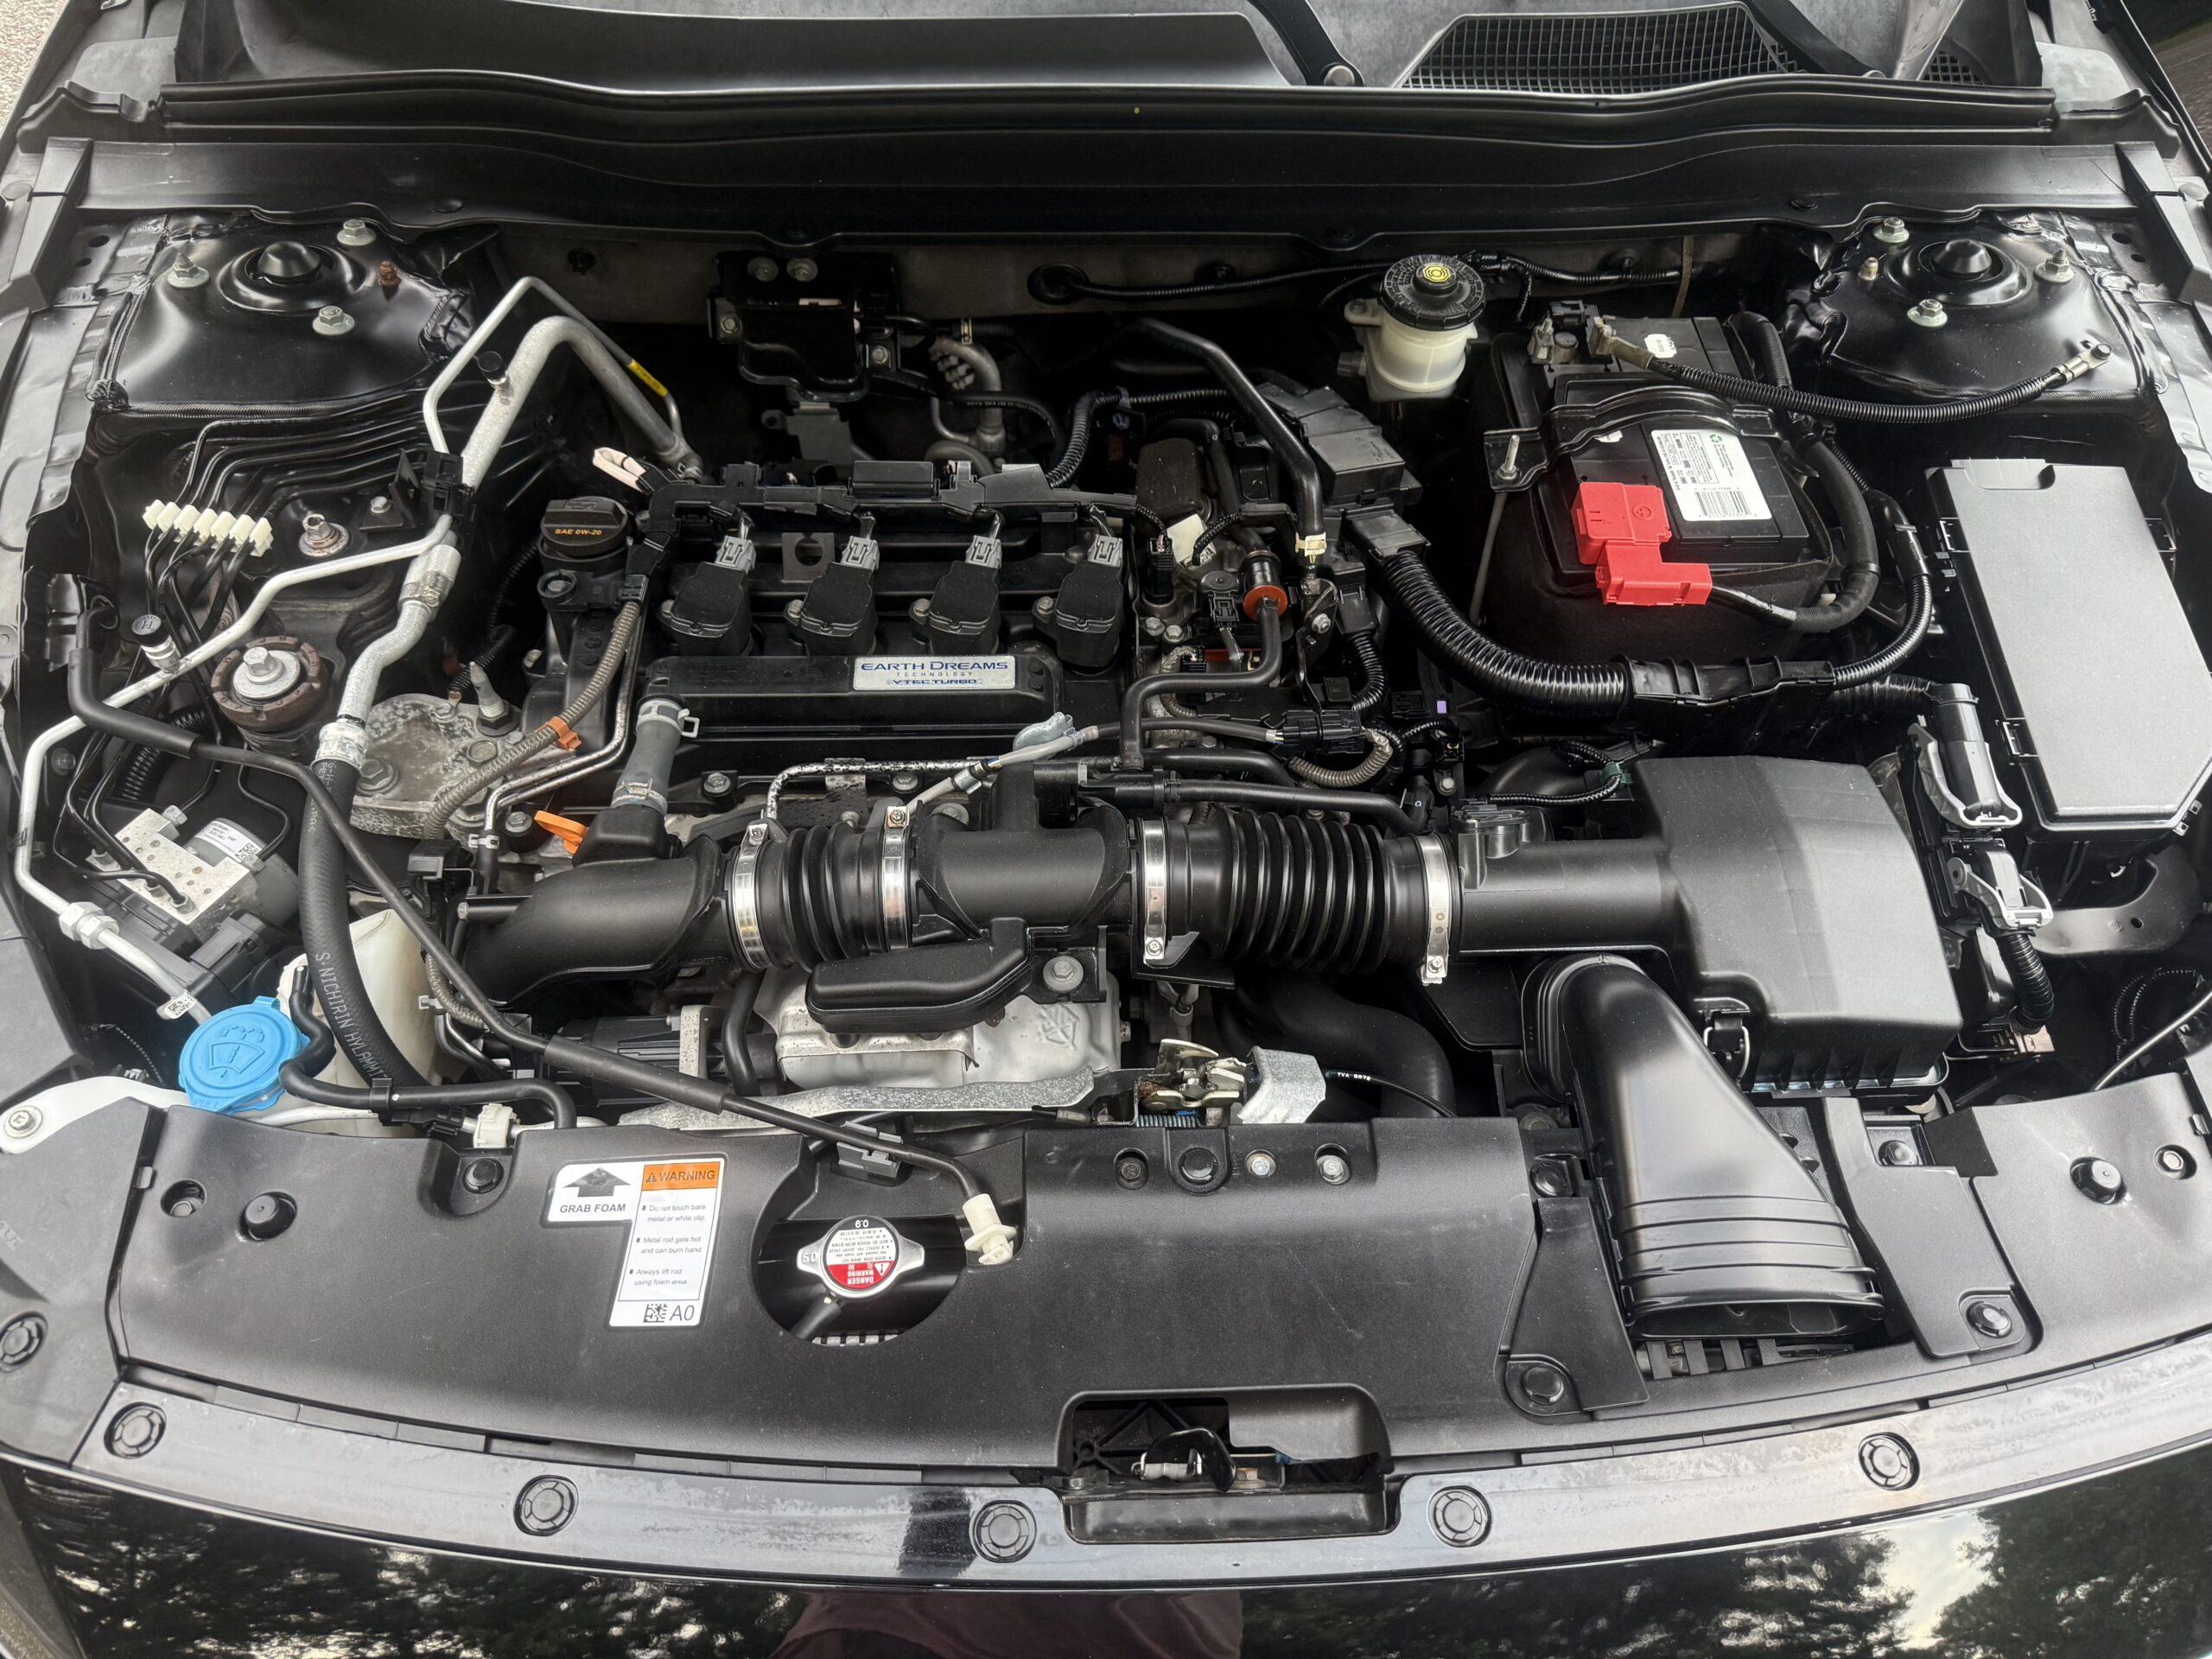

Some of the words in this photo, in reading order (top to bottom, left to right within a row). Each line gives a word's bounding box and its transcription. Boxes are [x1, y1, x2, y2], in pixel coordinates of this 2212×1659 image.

[930, 661, 1008, 670] DREAMS
[660, 1170, 716, 1182] WARNING
[559, 1204, 591, 1213] GRAB
[594, 1203, 626, 1213] FOAM
[855, 1219, 869, 1228] 0.9
[847, 1276, 874, 1285] DANGER
[669, 1305, 695, 1321] A0
